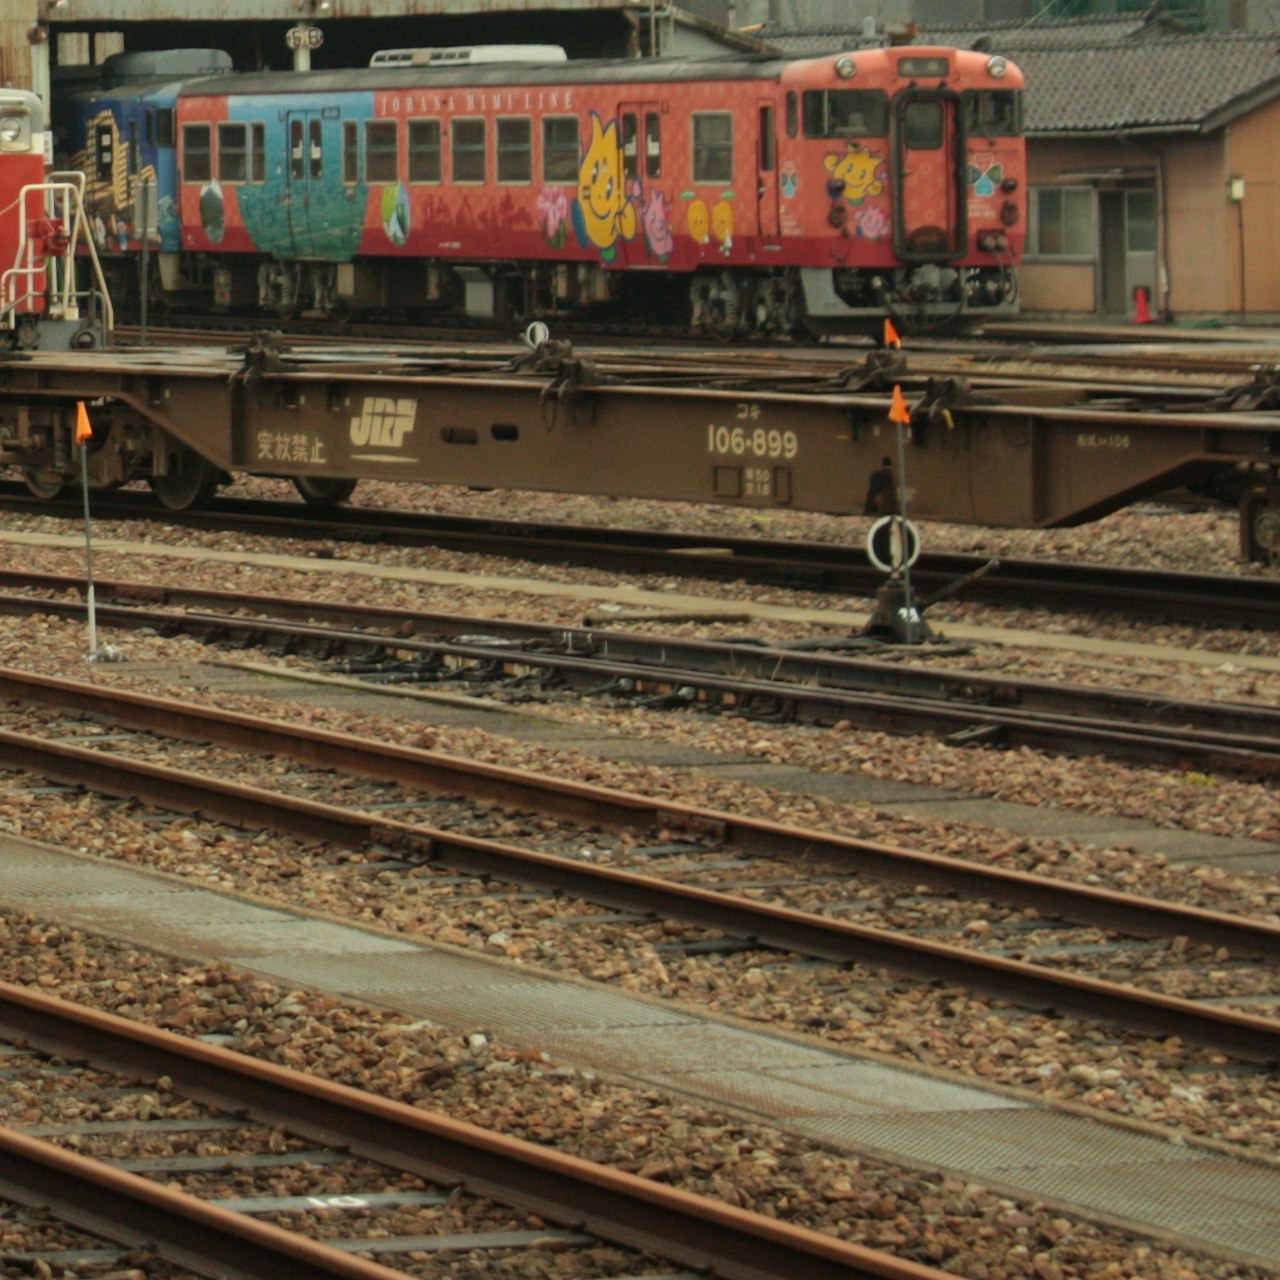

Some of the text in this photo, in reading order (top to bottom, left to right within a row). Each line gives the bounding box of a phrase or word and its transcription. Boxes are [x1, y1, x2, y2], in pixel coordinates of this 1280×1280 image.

[381, 91, 573, 115] JOHANA HIMI LINE
[350, 397, 418, 447] JRF
[257, 431, 327, 463] 突放禁止
